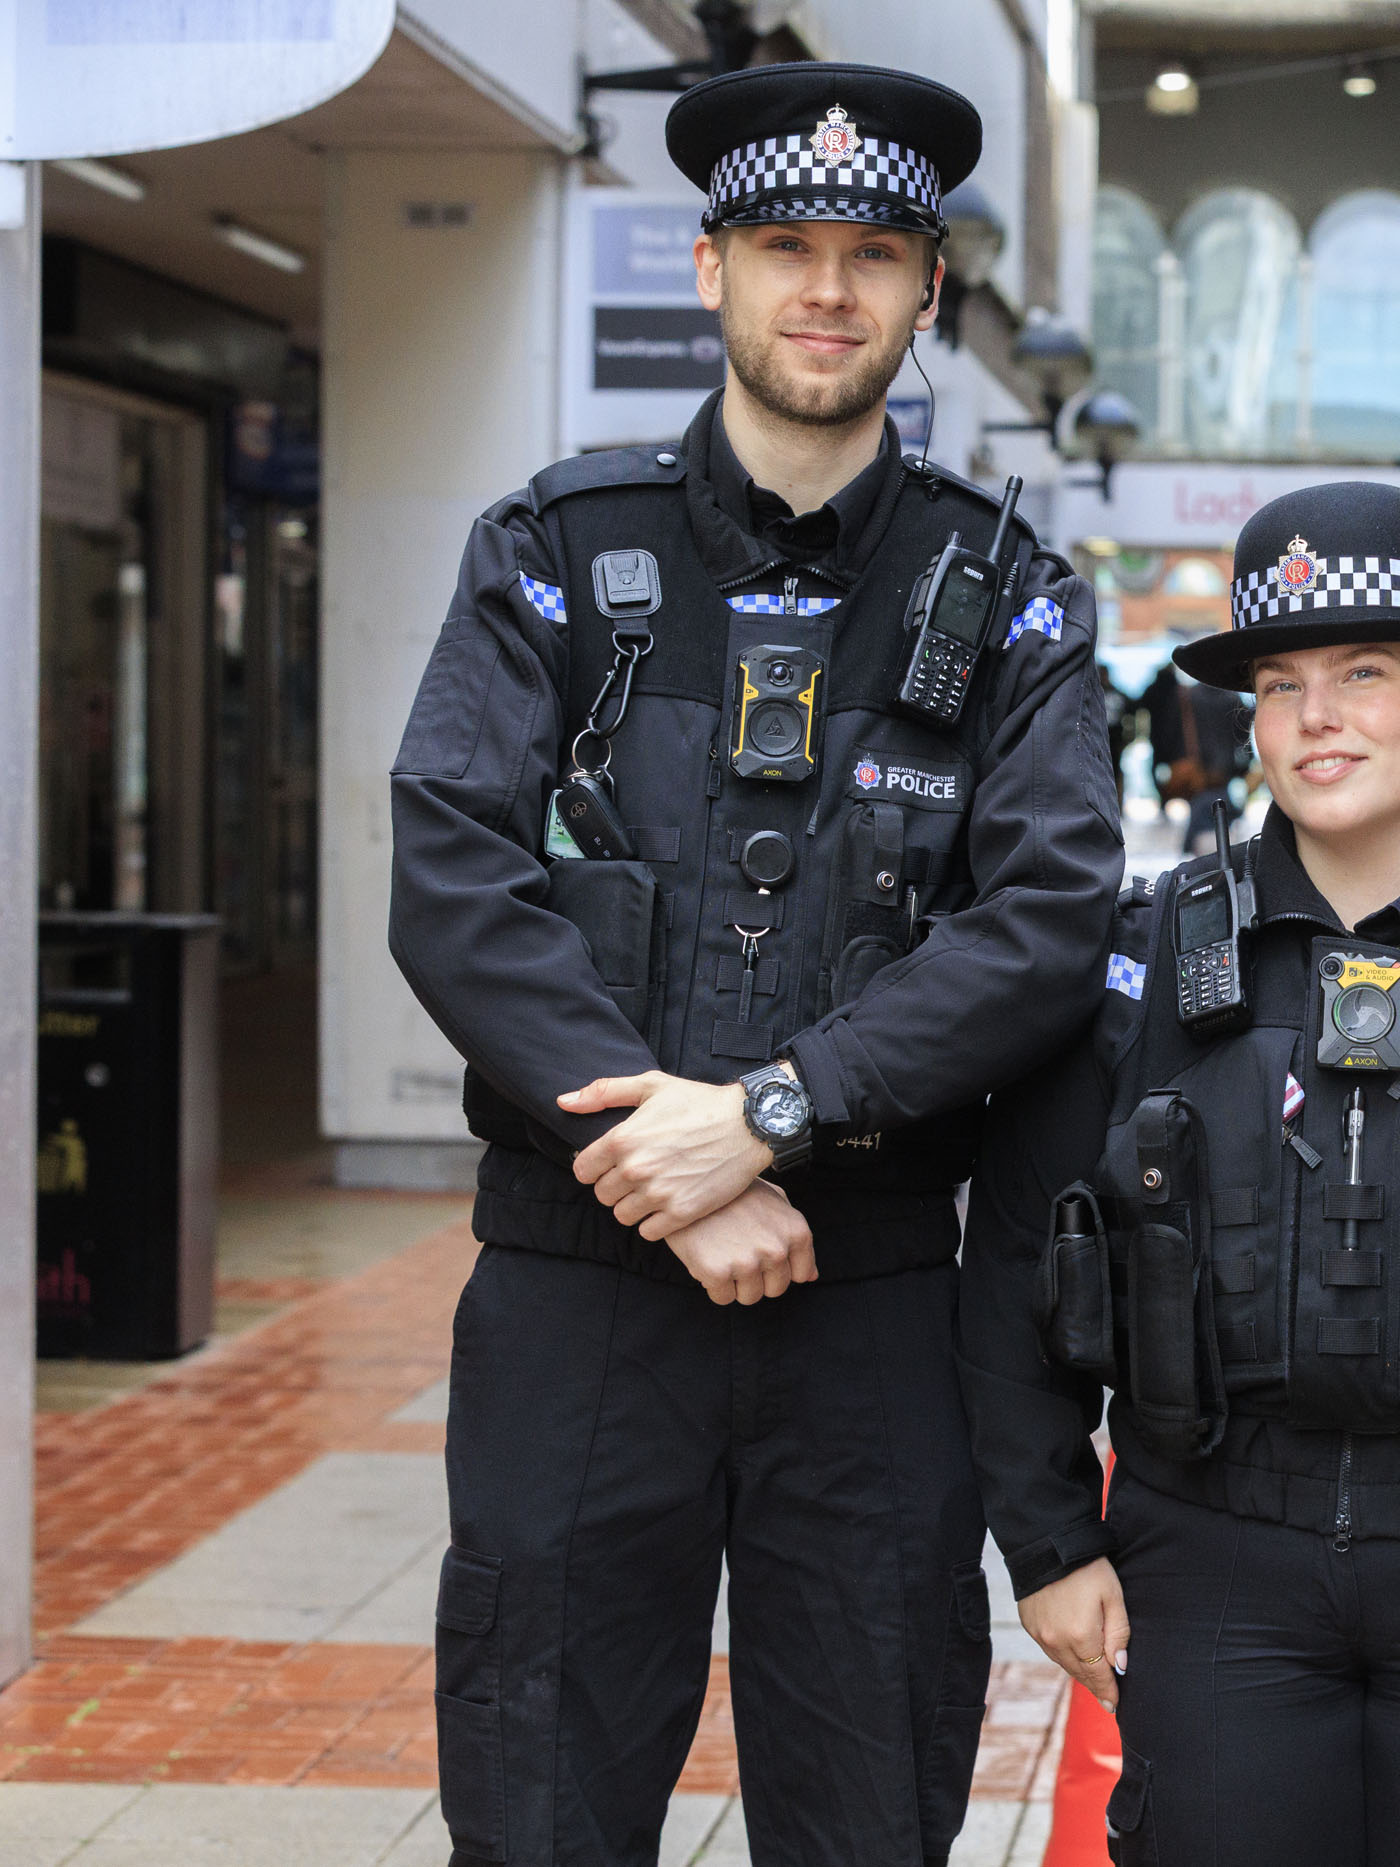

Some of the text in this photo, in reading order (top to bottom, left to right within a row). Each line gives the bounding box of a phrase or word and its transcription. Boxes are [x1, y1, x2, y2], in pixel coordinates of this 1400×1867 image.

[887, 766, 917, 776] GREATER
[917, 770, 956, 783] MANCHESTER
[886, 773, 956, 799] POLICE
[1354, 1057, 1378, 1065] AXON
